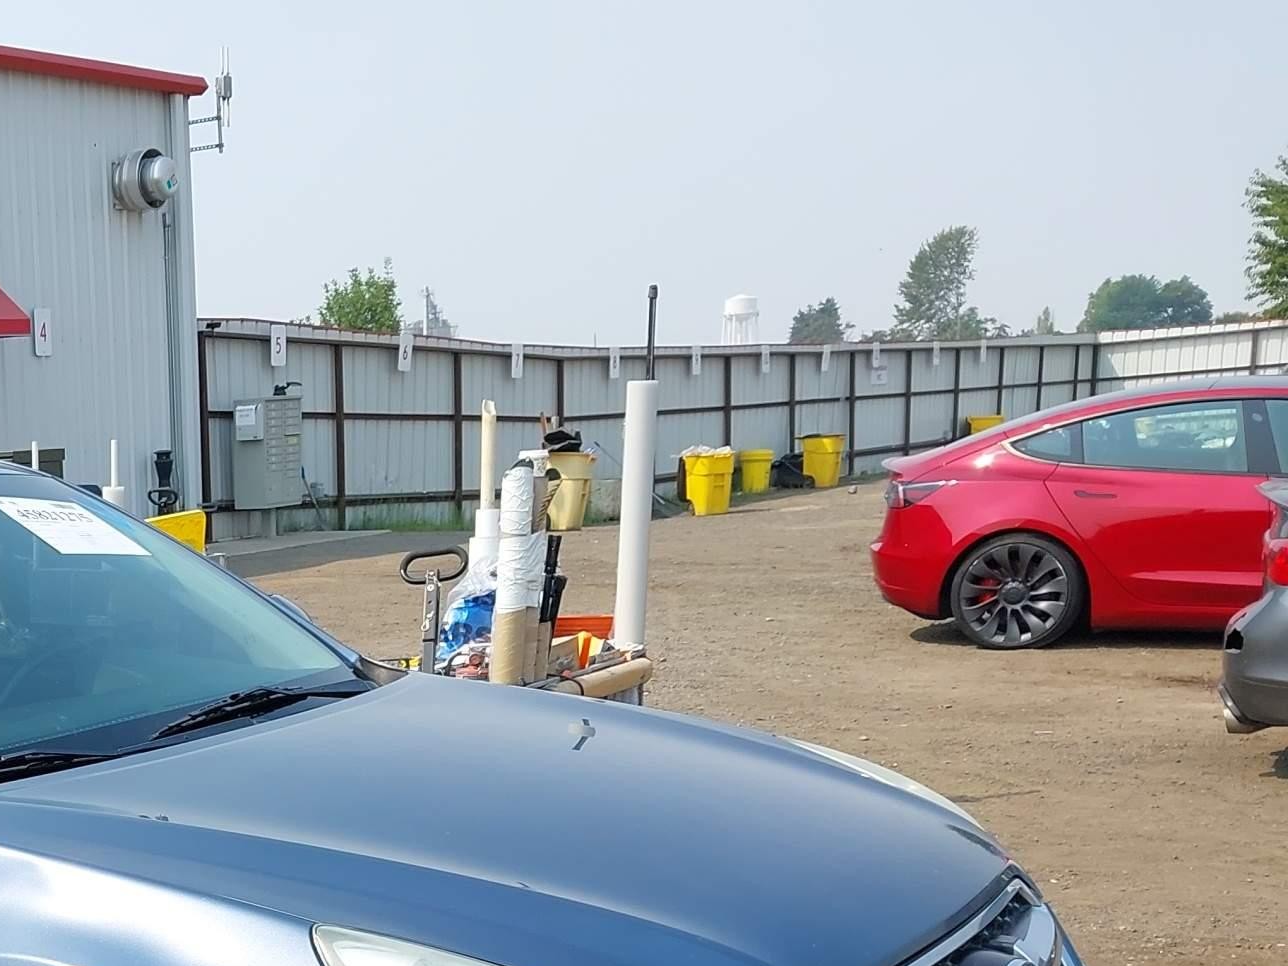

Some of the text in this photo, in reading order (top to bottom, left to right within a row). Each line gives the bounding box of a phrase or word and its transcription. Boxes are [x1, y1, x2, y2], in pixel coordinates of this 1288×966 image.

[40, 322, 47, 342] 4
[276, 337, 282, 354] 5
[403, 345, 408, 360] 6
[16, 509, 93, 523] 45821275
